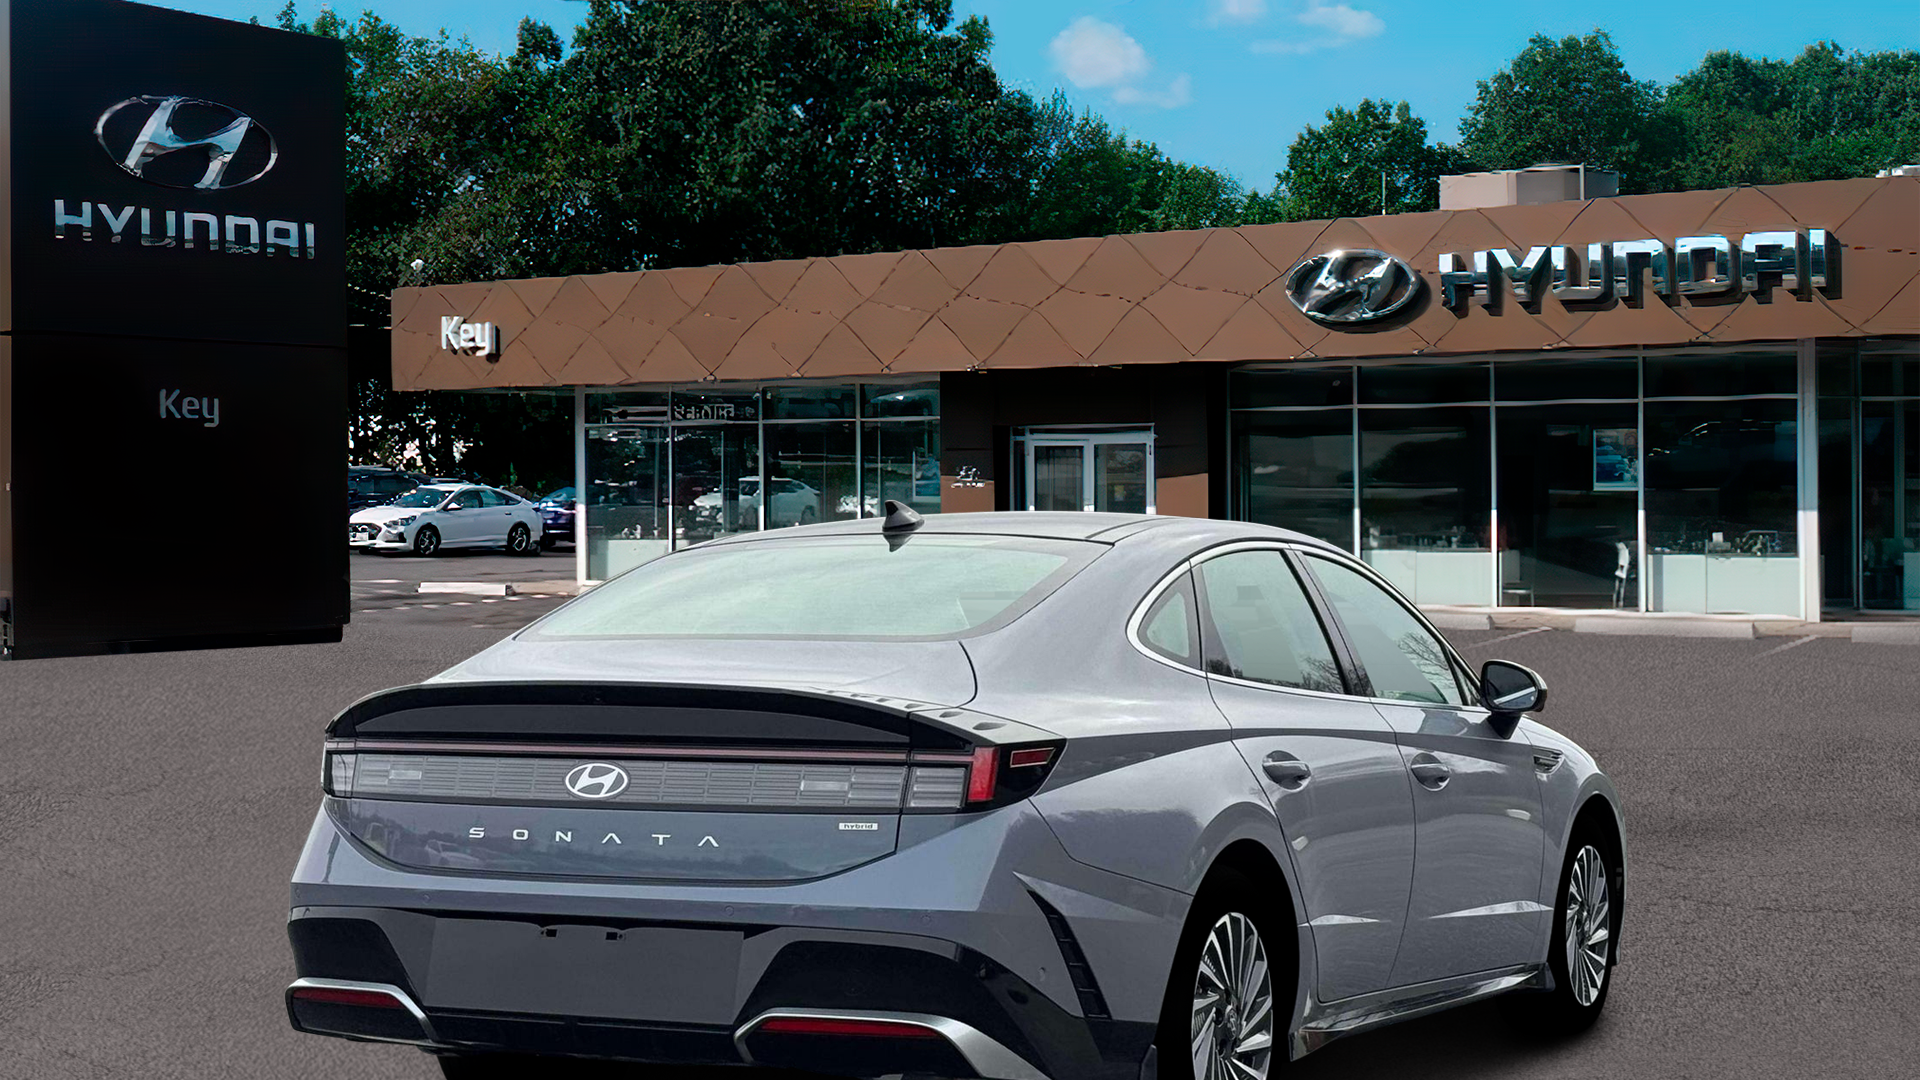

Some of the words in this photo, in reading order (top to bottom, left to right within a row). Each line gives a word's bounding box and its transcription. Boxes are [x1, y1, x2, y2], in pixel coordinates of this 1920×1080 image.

[54, 199, 315, 260] HYUNDAI
[1438, 228, 1839, 312] HYUNDAI
[441, 315, 494, 357] Key
[158, 388, 220, 427] Key
[468, 827, 720, 848] SONATA
[842, 822, 875, 830] hybrid
